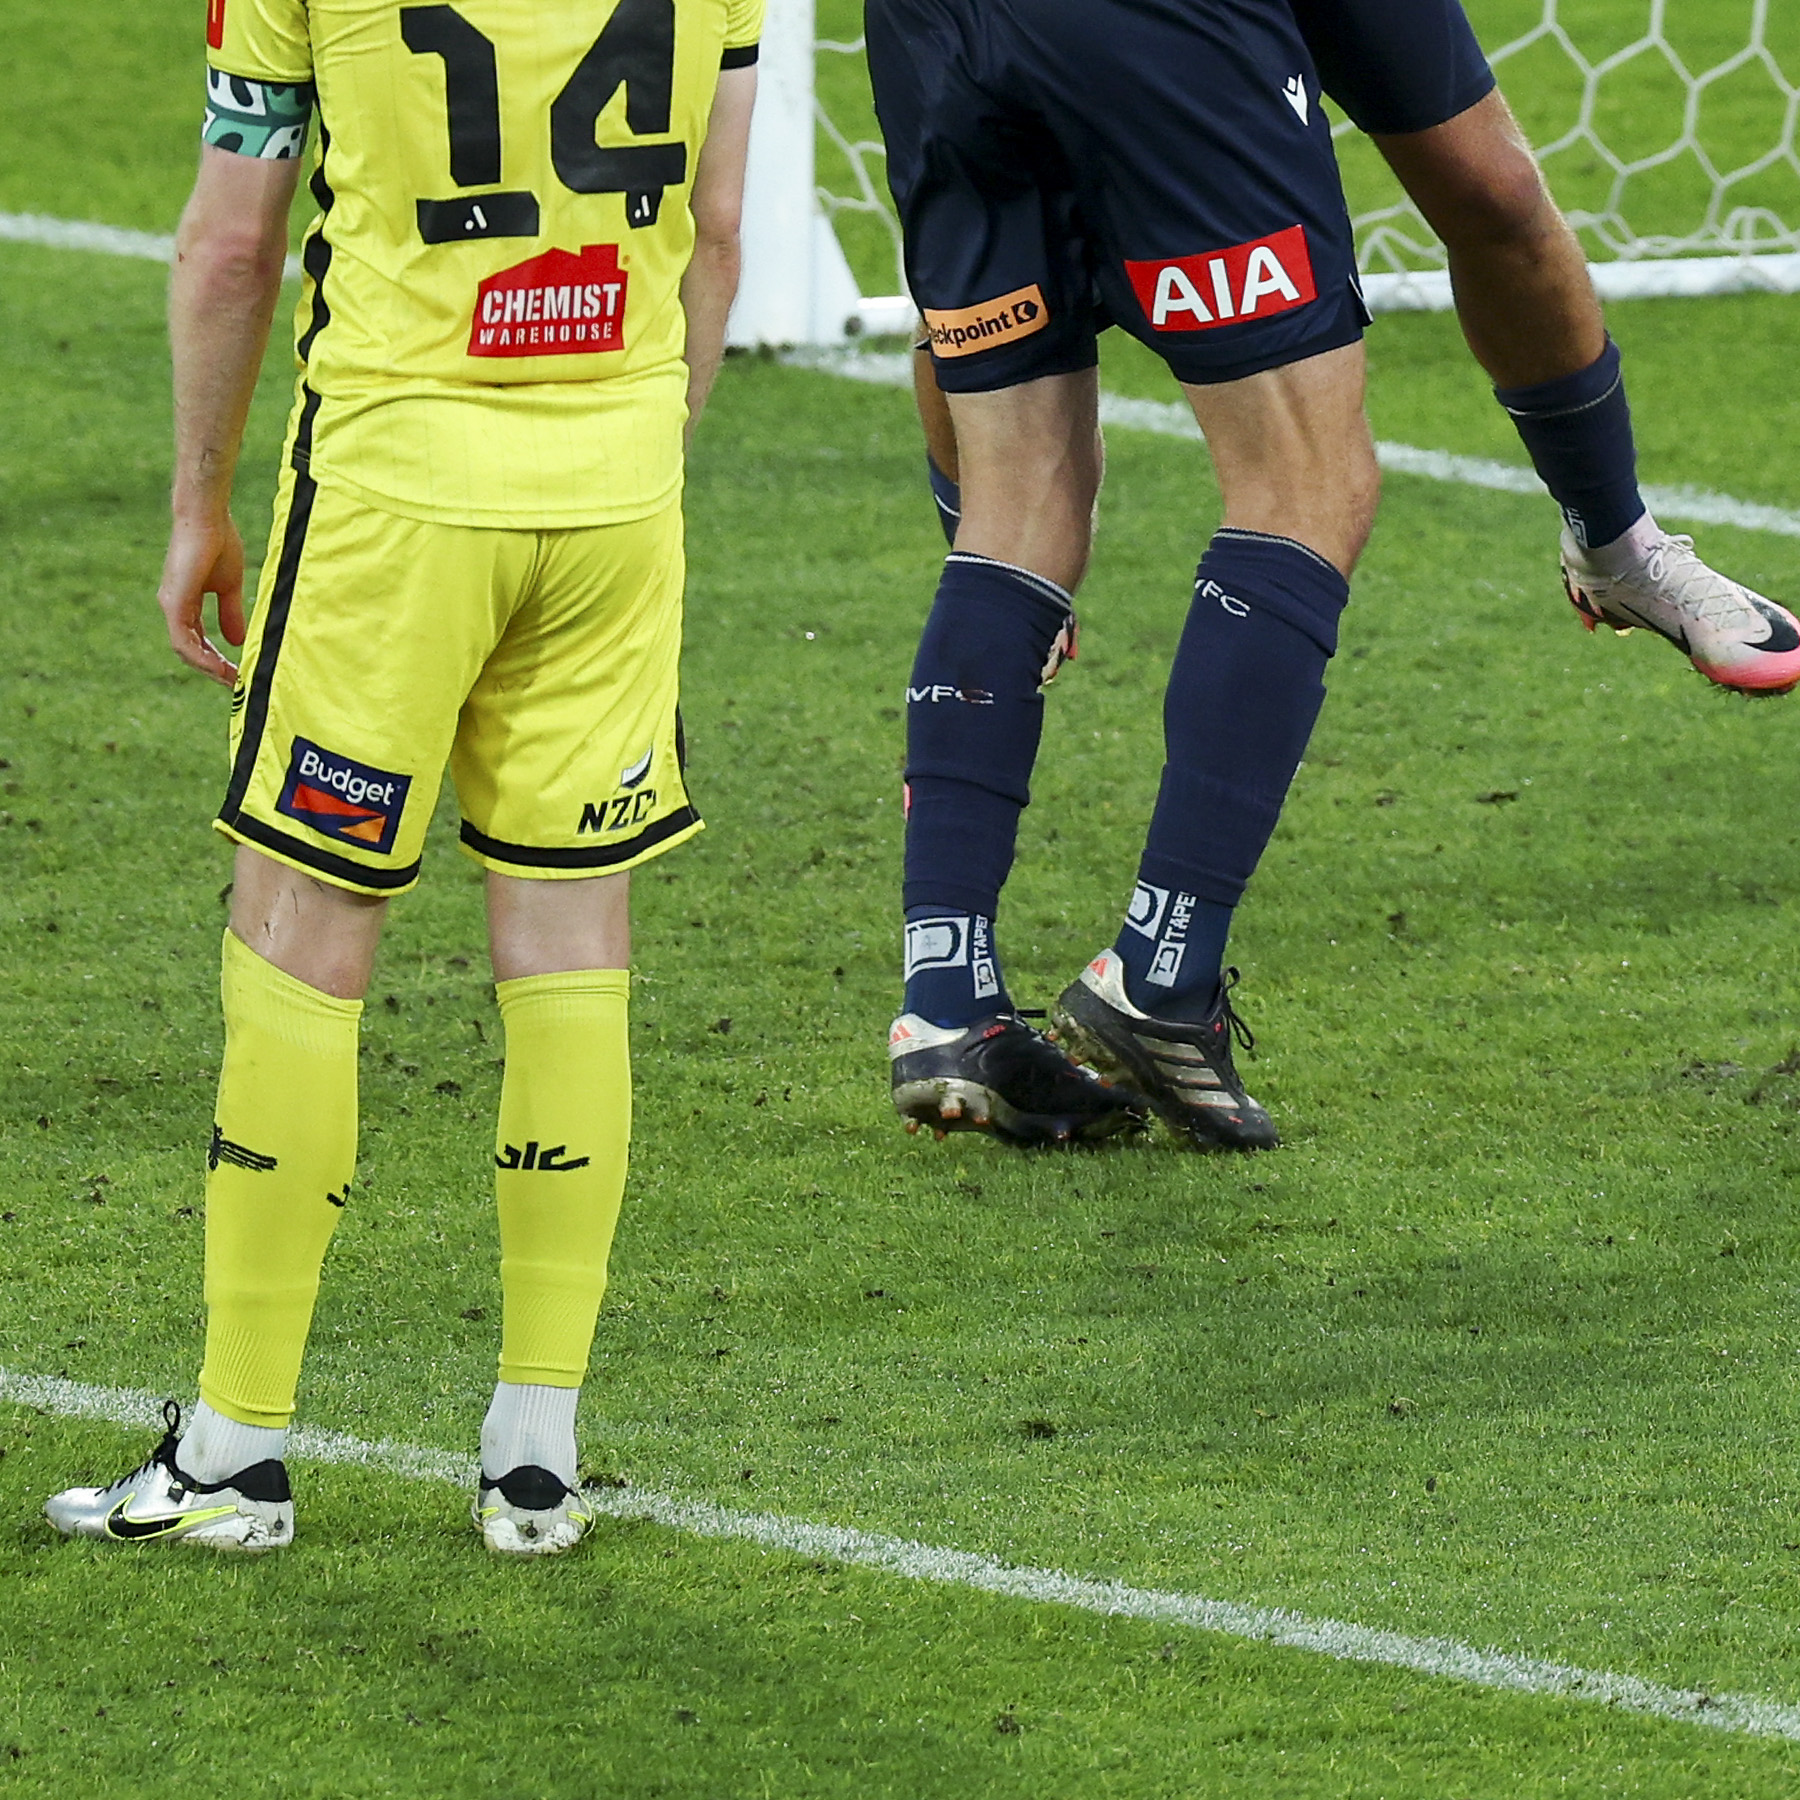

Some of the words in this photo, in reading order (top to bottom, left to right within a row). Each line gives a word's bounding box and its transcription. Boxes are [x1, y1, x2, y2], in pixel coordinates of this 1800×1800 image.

[482, 282, 622, 325] CHEMIST
[1151, 244, 1300, 326] AIA
[479, 321, 614, 346] WAREHOUSE
[1194, 579, 1250, 618] FC
[299, 749, 397, 807] Budget
[577, 789, 657, 836] NZC
